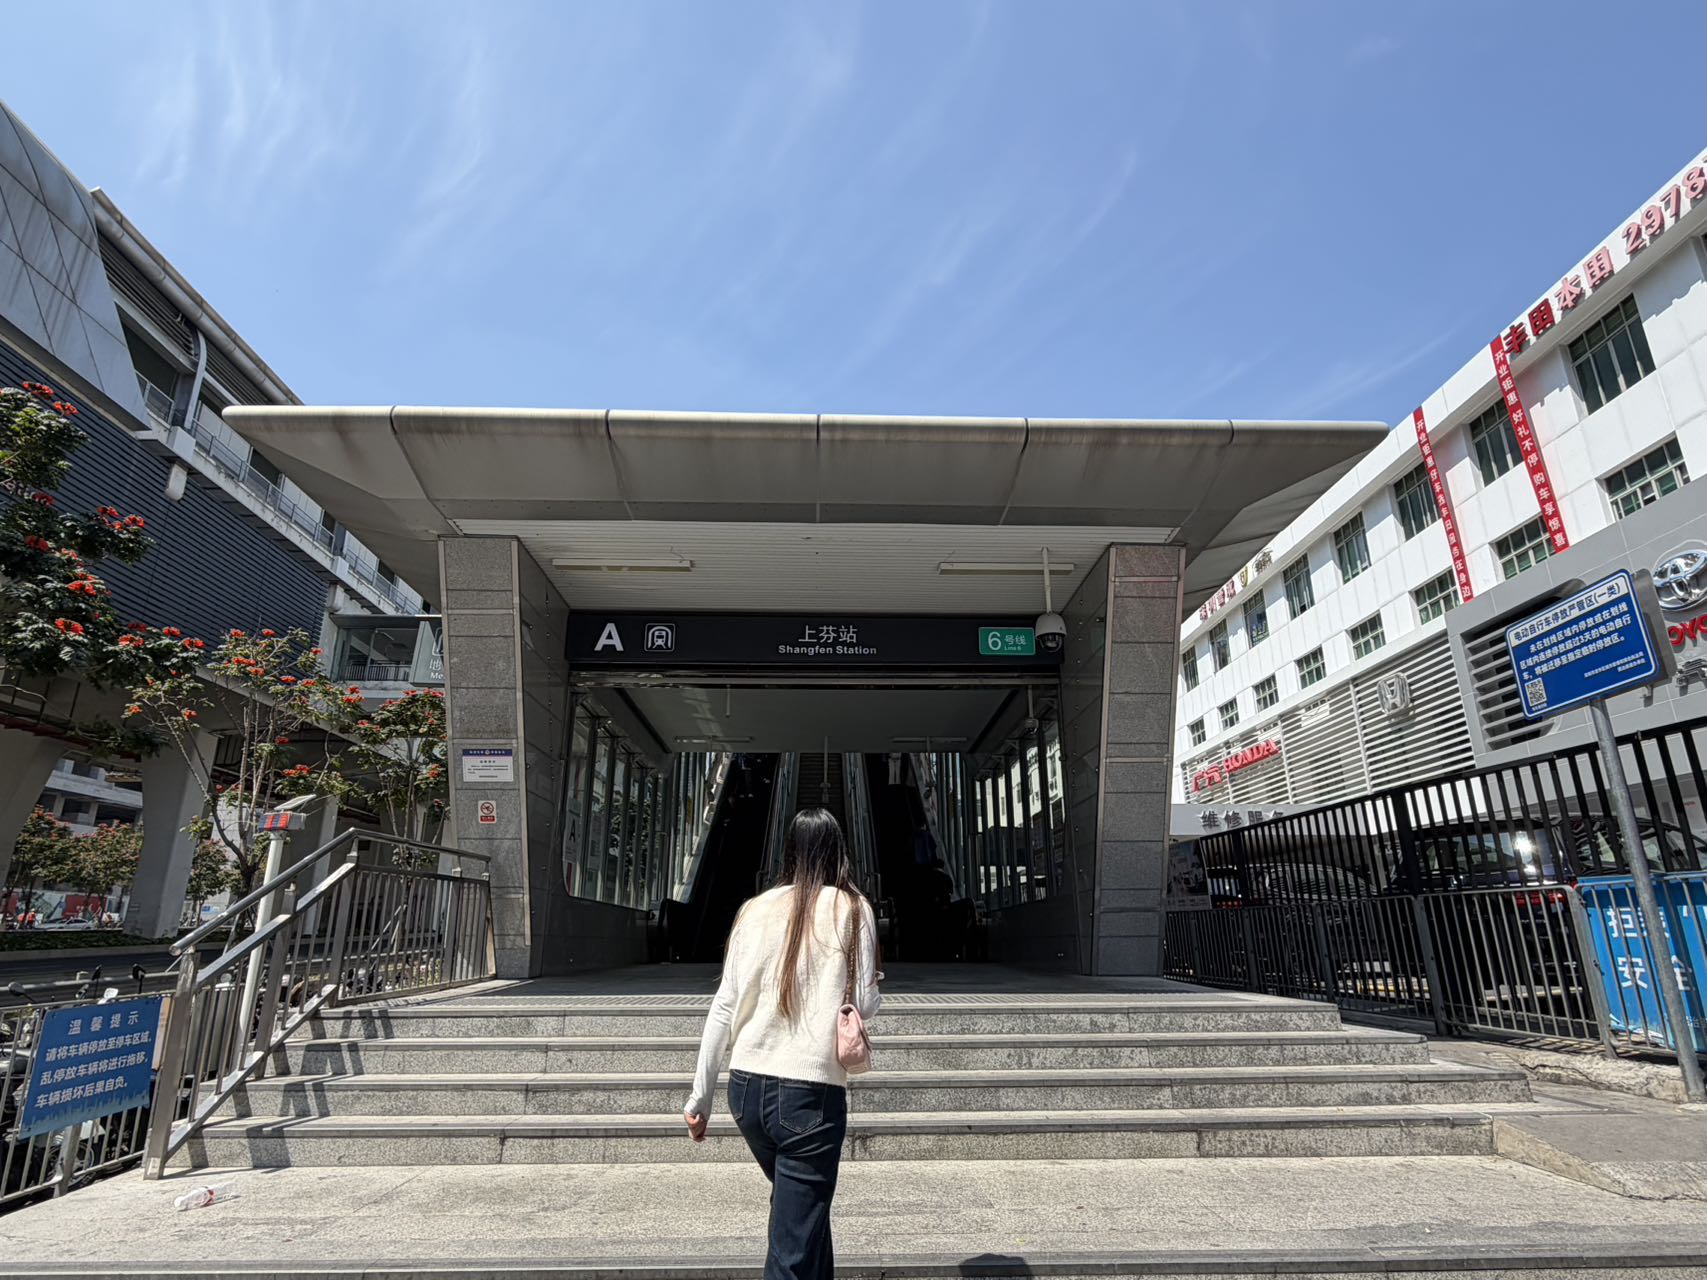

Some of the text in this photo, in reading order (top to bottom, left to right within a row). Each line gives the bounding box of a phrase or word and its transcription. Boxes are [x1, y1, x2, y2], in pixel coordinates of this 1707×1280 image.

[1503, 155, 1707, 354] 丰田本田 2978
[1512, 409, 1539, 467] 好礼不停
[1533, 471, 1567, 547] 购车享惊喜
[1514, 582, 1620, 641] 电动自行车停放严管区(一类)
[594, 622, 624, 651] A
[798, 624, 858, 643] 上芬站
[988, 631, 1002, 651] 6
[1004, 634, 1026, 645] 号线
[778, 645, 877, 656] Shangfen Station
[68, 1010, 139, 1035] 温馨提示
